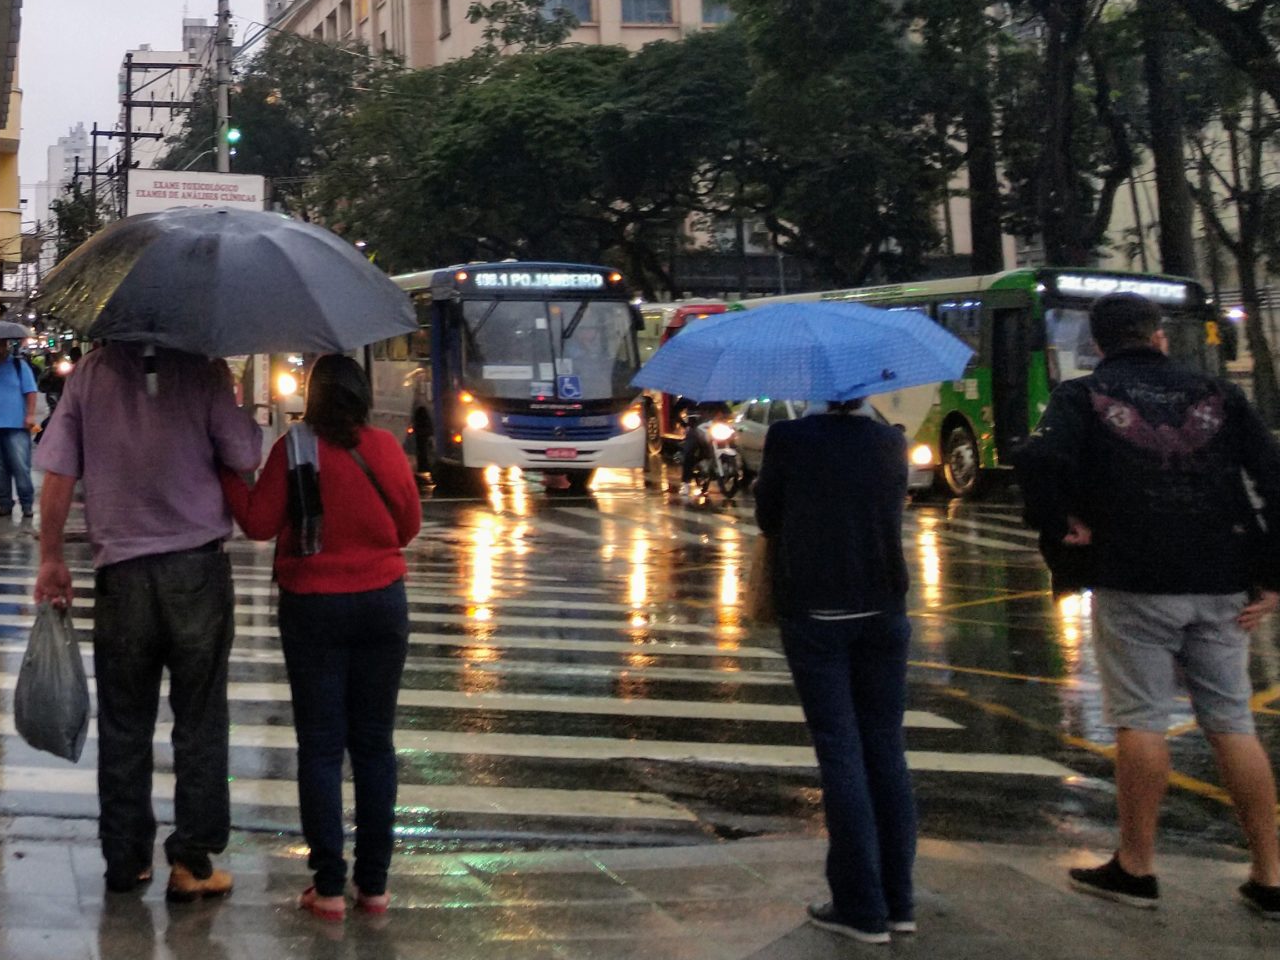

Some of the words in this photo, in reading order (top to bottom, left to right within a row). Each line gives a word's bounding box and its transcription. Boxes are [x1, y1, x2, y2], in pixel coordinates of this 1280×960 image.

[153, 181, 179, 189] EXAME
[136, 190, 166, 198] EXAMES
[168, 191, 179, 199] DE
